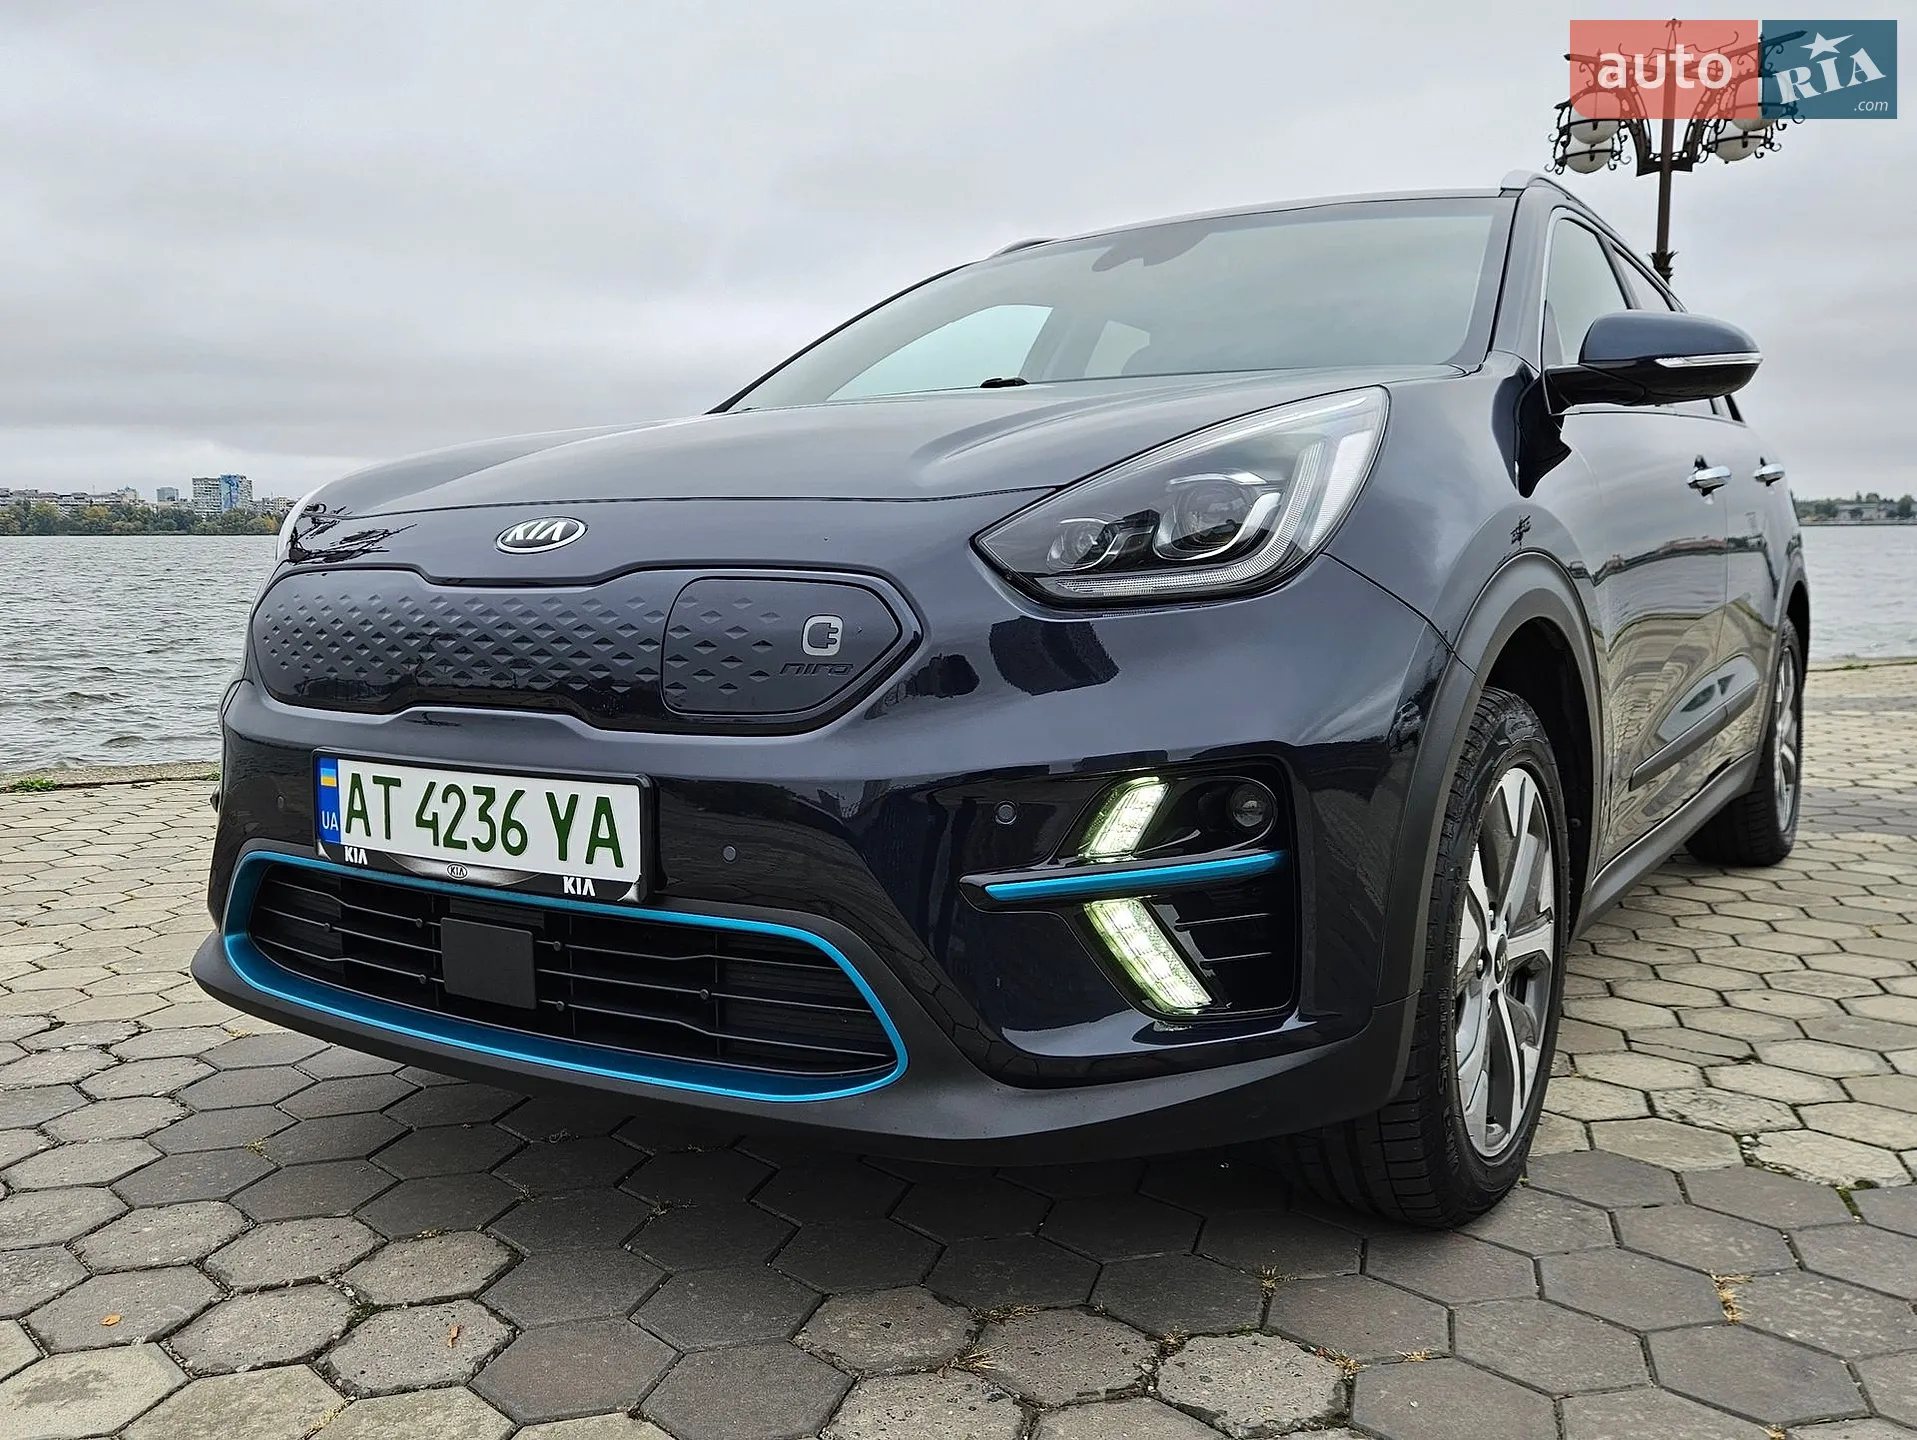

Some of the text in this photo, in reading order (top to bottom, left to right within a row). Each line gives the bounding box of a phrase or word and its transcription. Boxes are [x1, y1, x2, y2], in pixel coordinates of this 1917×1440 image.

[321, 810, 339, 831] UA
[345, 772, 624, 869] AT 4236 YA
[344, 845, 368, 866] KIA
[563, 875, 596, 897] KIA
